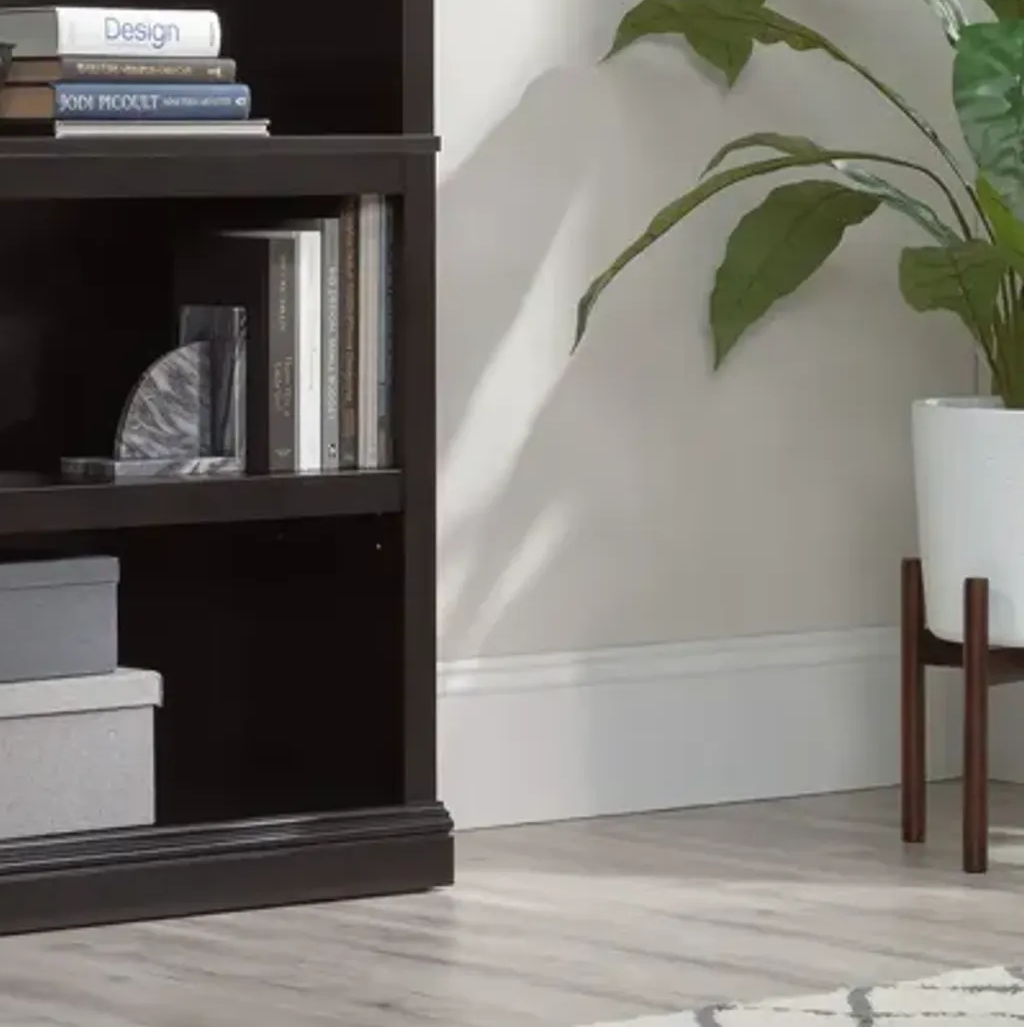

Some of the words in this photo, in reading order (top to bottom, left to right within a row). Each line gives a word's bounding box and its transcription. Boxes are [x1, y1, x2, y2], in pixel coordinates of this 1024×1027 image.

[104, 17, 180, 48] Design
[60, 93, 93, 112] JODI
[98, 94, 161, 112] PICOULT
